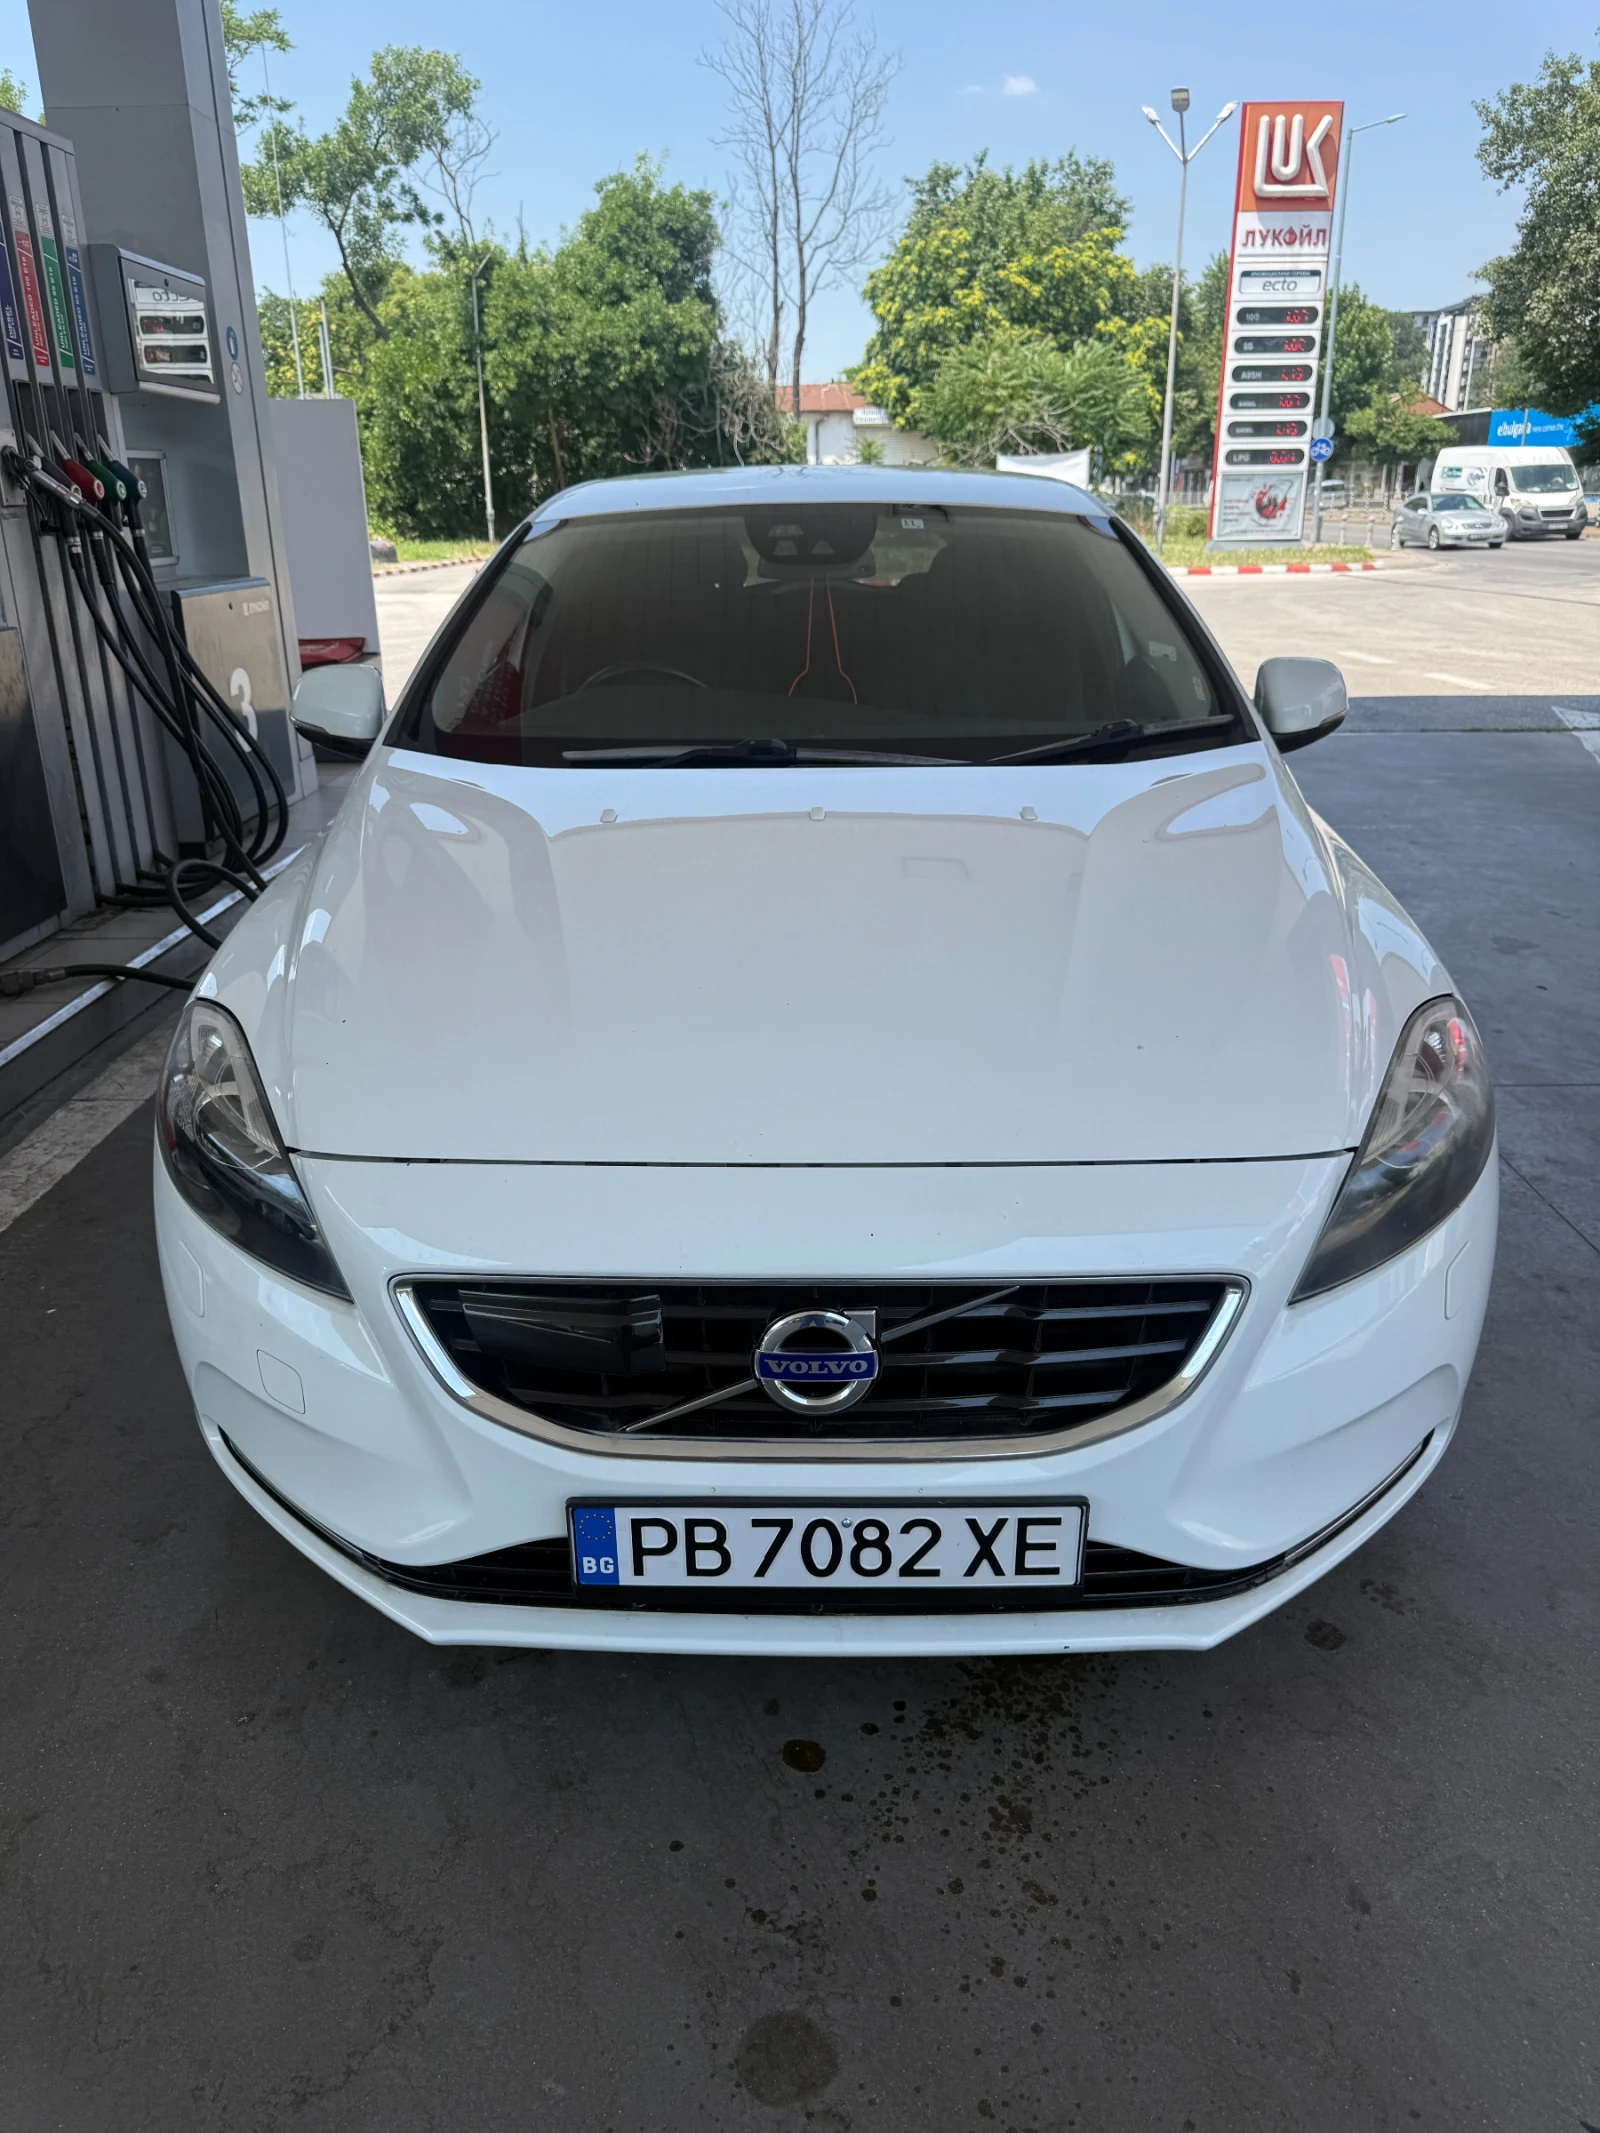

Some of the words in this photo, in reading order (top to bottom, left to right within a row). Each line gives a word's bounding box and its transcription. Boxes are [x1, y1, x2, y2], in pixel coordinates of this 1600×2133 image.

[1262, 278, 1298, 292] ecto
[28, 294, 41, 346] UNLEADED
[54, 299, 66, 349] UNLEADED
[76, 306, 88, 356] UNLEADED
[231, 668, 258, 753] 3
[764, 1359, 868, 1374] VOLVO
[582, 1556, 615, 1575] BG
[629, 1517, 732, 1578] PB
[750, 1517, 943, 1579] 7082
[962, 1516, 1064, 1577] XE
